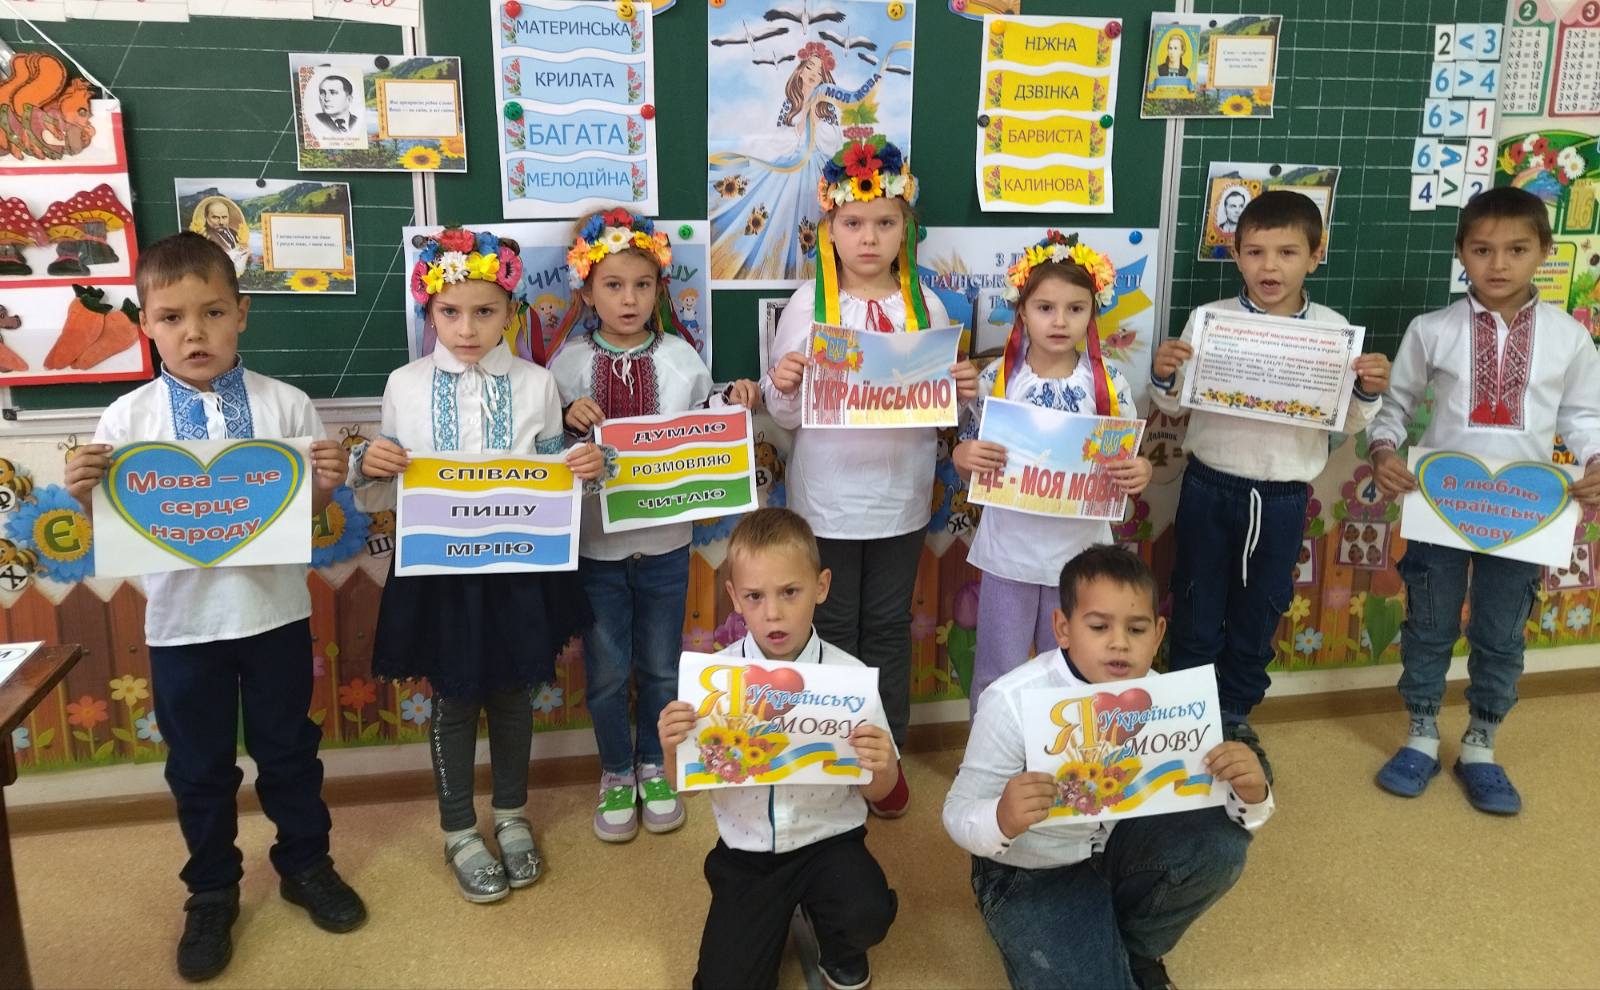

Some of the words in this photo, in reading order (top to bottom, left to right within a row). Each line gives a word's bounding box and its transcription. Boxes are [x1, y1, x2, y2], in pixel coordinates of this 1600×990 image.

[1523, 4, 1533, 16] 2
[1586, 5, 1596, 17] 3
[516, 20, 631, 36] МАТЕРИНСЬКА
[1025, 36, 1077, 51] НІЖНА
[1438, 32, 1451, 56] 2
[1483, 29, 1496, 53] 3
[535, 72, 614, 88] КРИЛАТА
[825, 86, 851, 103] МОЯ
[854, 73, 882, 101] МОВА
[1435, 68, 1449, 92] 6
[1480, 69, 1495, 93] 4
[1014, 84, 1079, 101] ДЗВІНКА
[1428, 104, 1442, 128] 6
[1477, 108, 1487, 129] 1
[529, 123, 624, 145] БАГАТА
[1008, 129, 1083, 144] БАРВИСТА
[1417, 144, 1431, 168] 6
[1475, 145, 1489, 167] 3
[526, 167, 630, 189] МЕЛОДІЙНА
[1004, 178, 1084, 192] КАЛИНОВА
[1418, 182, 1432, 203] 4
[813, 378, 951, 411] УКРАЇНСЬКОЮ
[632, 422, 726, 445] ДУМАЮ
[632, 453, 731, 477] РОЗМОВЛЯЮ
[1148, 442, 1168, 467] 4
[126, 470, 211, 494] Мова
[246, 470, 281, 489] це
[438, 468, 549, 481] СПІВАЮ
[1020, 465, 1066, 499] МОЯ
[1068, 472, 1121, 501] МОВА
[638, 488, 726, 510] ЧИТАЮ
[1362, 481, 1377, 502] 4
[1442, 476, 1457, 490] Я
[1463, 477, 1540, 502] люблю
[160, 496, 250, 518] серце
[450, 504, 537, 518] ПИШУ
[1432, 496, 1550, 524] українську
[44, 515, 81, 552] Є
[150, 517, 260, 545] народу
[1458, 520, 1513, 542] мову
[446, 542, 535, 557] МРІЮ
[696, 665, 748, 718] Я
[747, 684, 866, 713] Українську
[1044, 696, 1098, 755] Я
[1099, 700, 1206, 732] Українську
